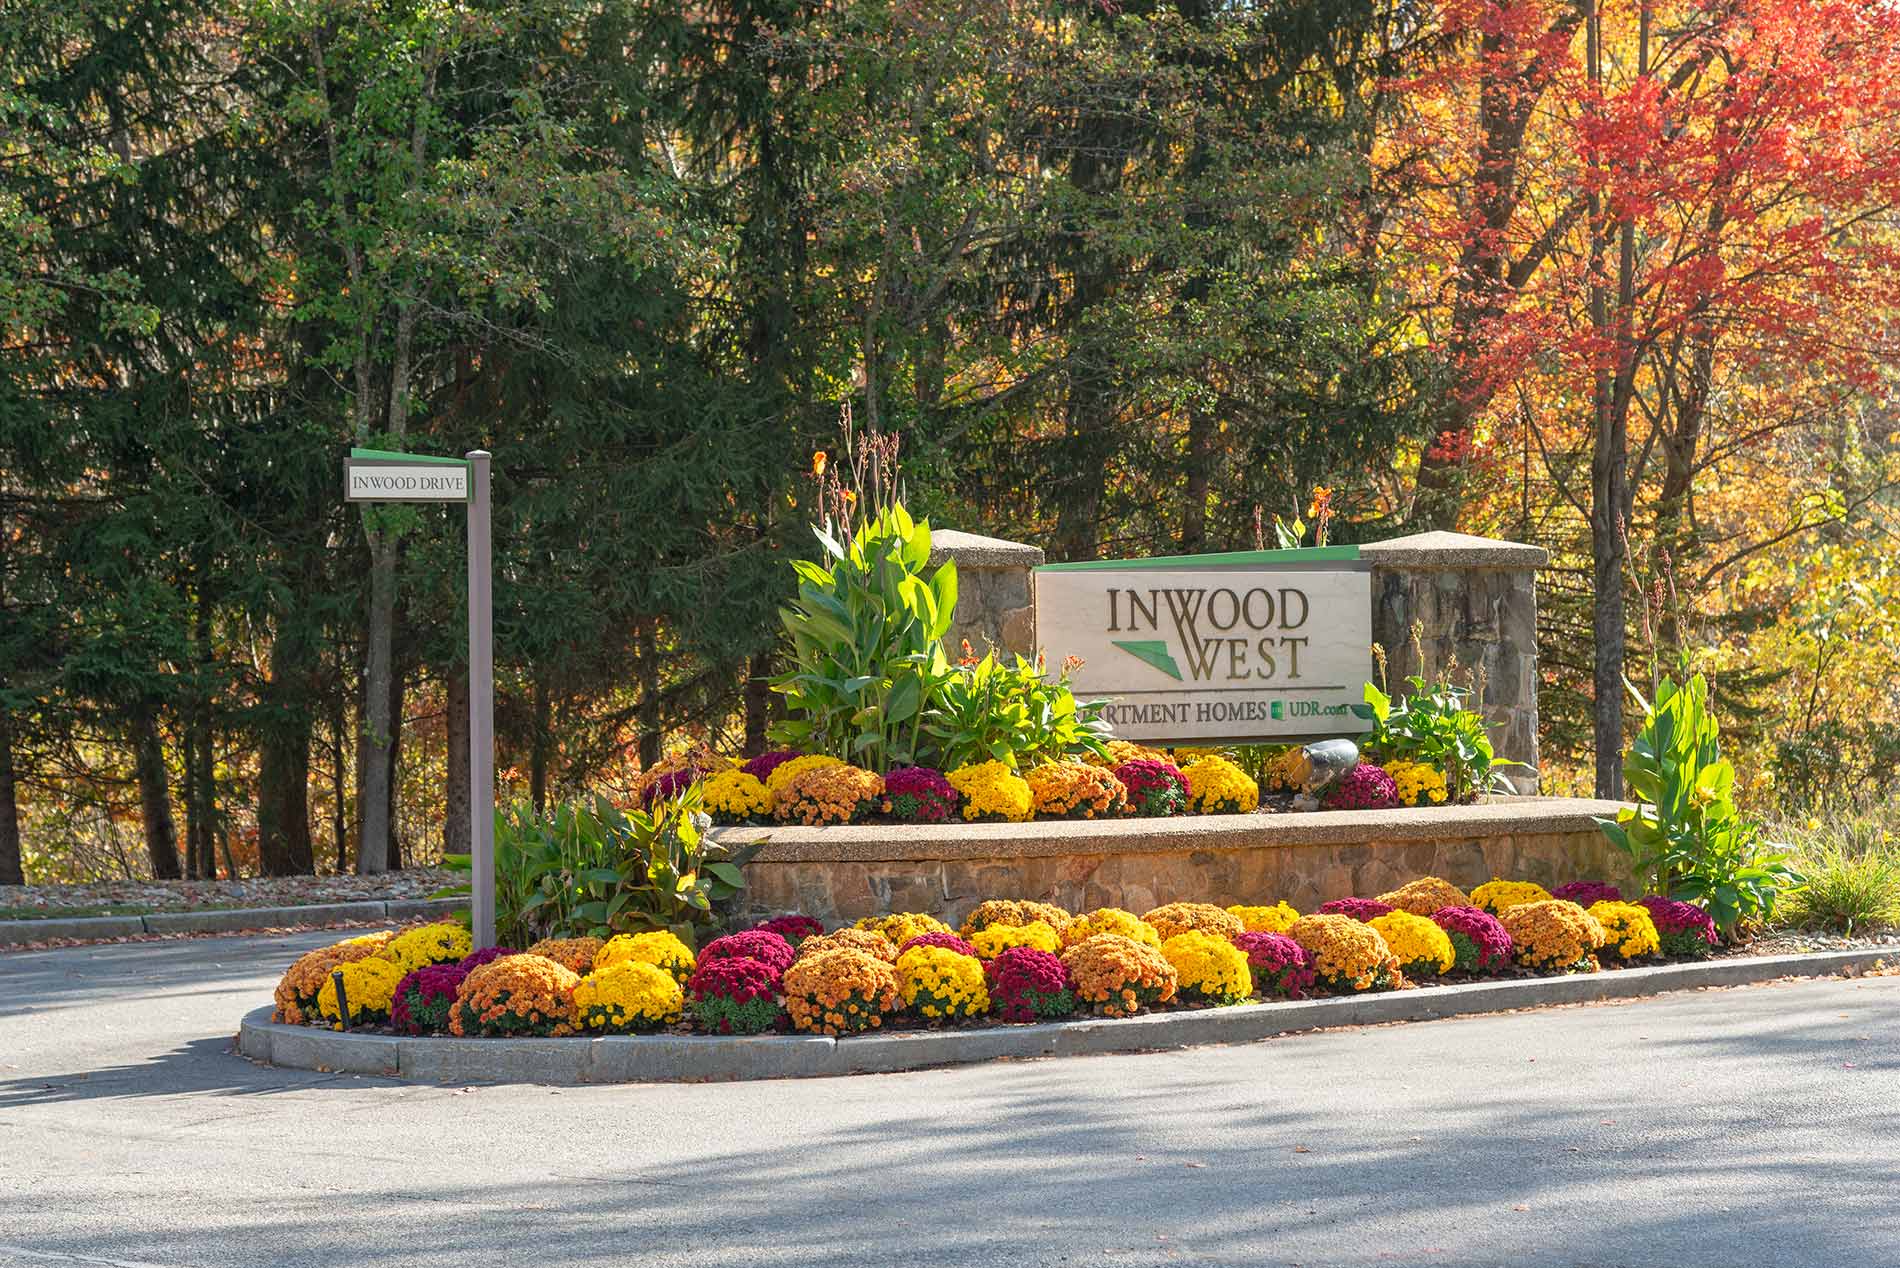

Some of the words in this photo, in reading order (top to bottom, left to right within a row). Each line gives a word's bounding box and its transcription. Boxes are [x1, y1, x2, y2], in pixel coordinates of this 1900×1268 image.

[353, 476, 417, 490] INWOOD
[420, 476, 465, 490] DRIVE
[1106, 588, 1309, 631] INWOOD
[1180, 636, 1309, 681] WEST
[1076, 703, 1191, 725] RTMENT
[1196, 702, 1267, 722] HOMES
